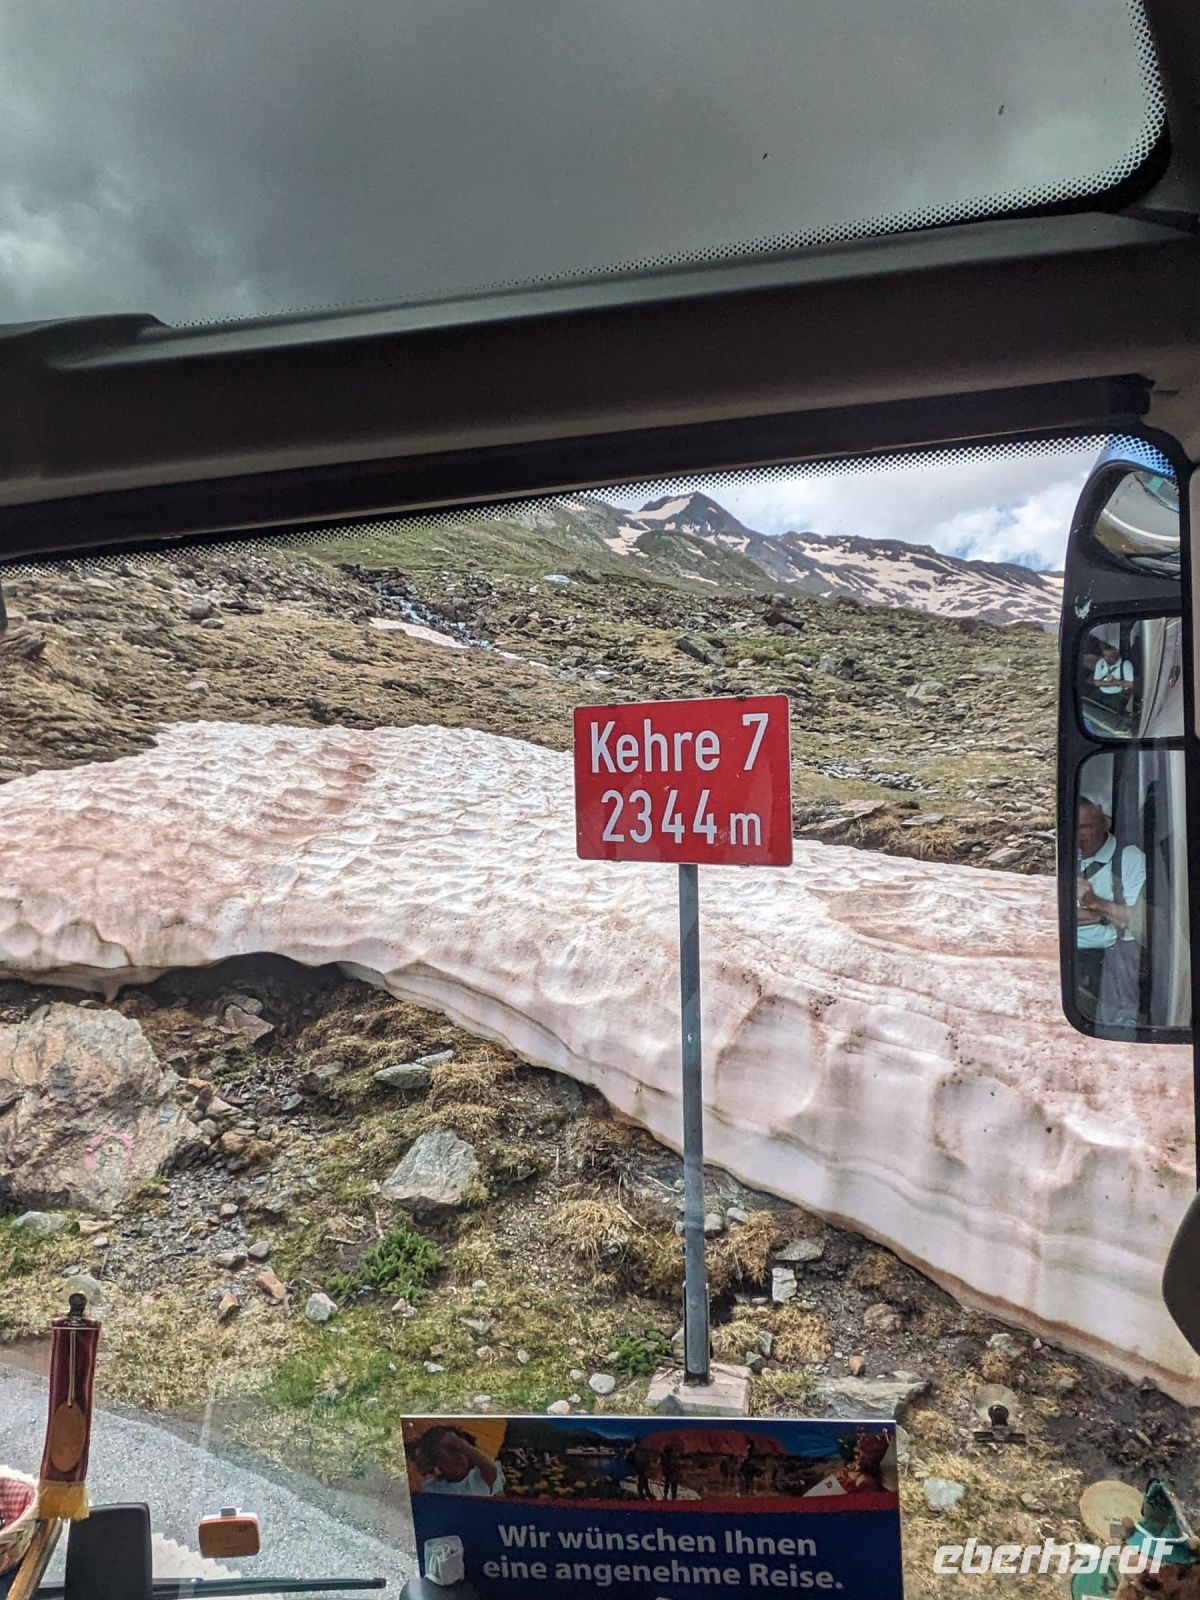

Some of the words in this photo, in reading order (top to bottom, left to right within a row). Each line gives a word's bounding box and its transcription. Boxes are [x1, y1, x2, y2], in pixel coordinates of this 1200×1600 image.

[590, 718, 721, 774] Kehre
[742, 712, 769, 771] 7
[601, 789, 718, 844] 2344
[730, 812, 762, 846] m
[498, 1524, 551, 1549] Wir
[557, 1527, 716, 1554] wünschen
[724, 1529, 818, 1557] Ihnen
[482, 1554, 548, 1579] eine
[555, 1559, 742, 1587] angenehme
[749, 1563, 844, 1590] Reise.
